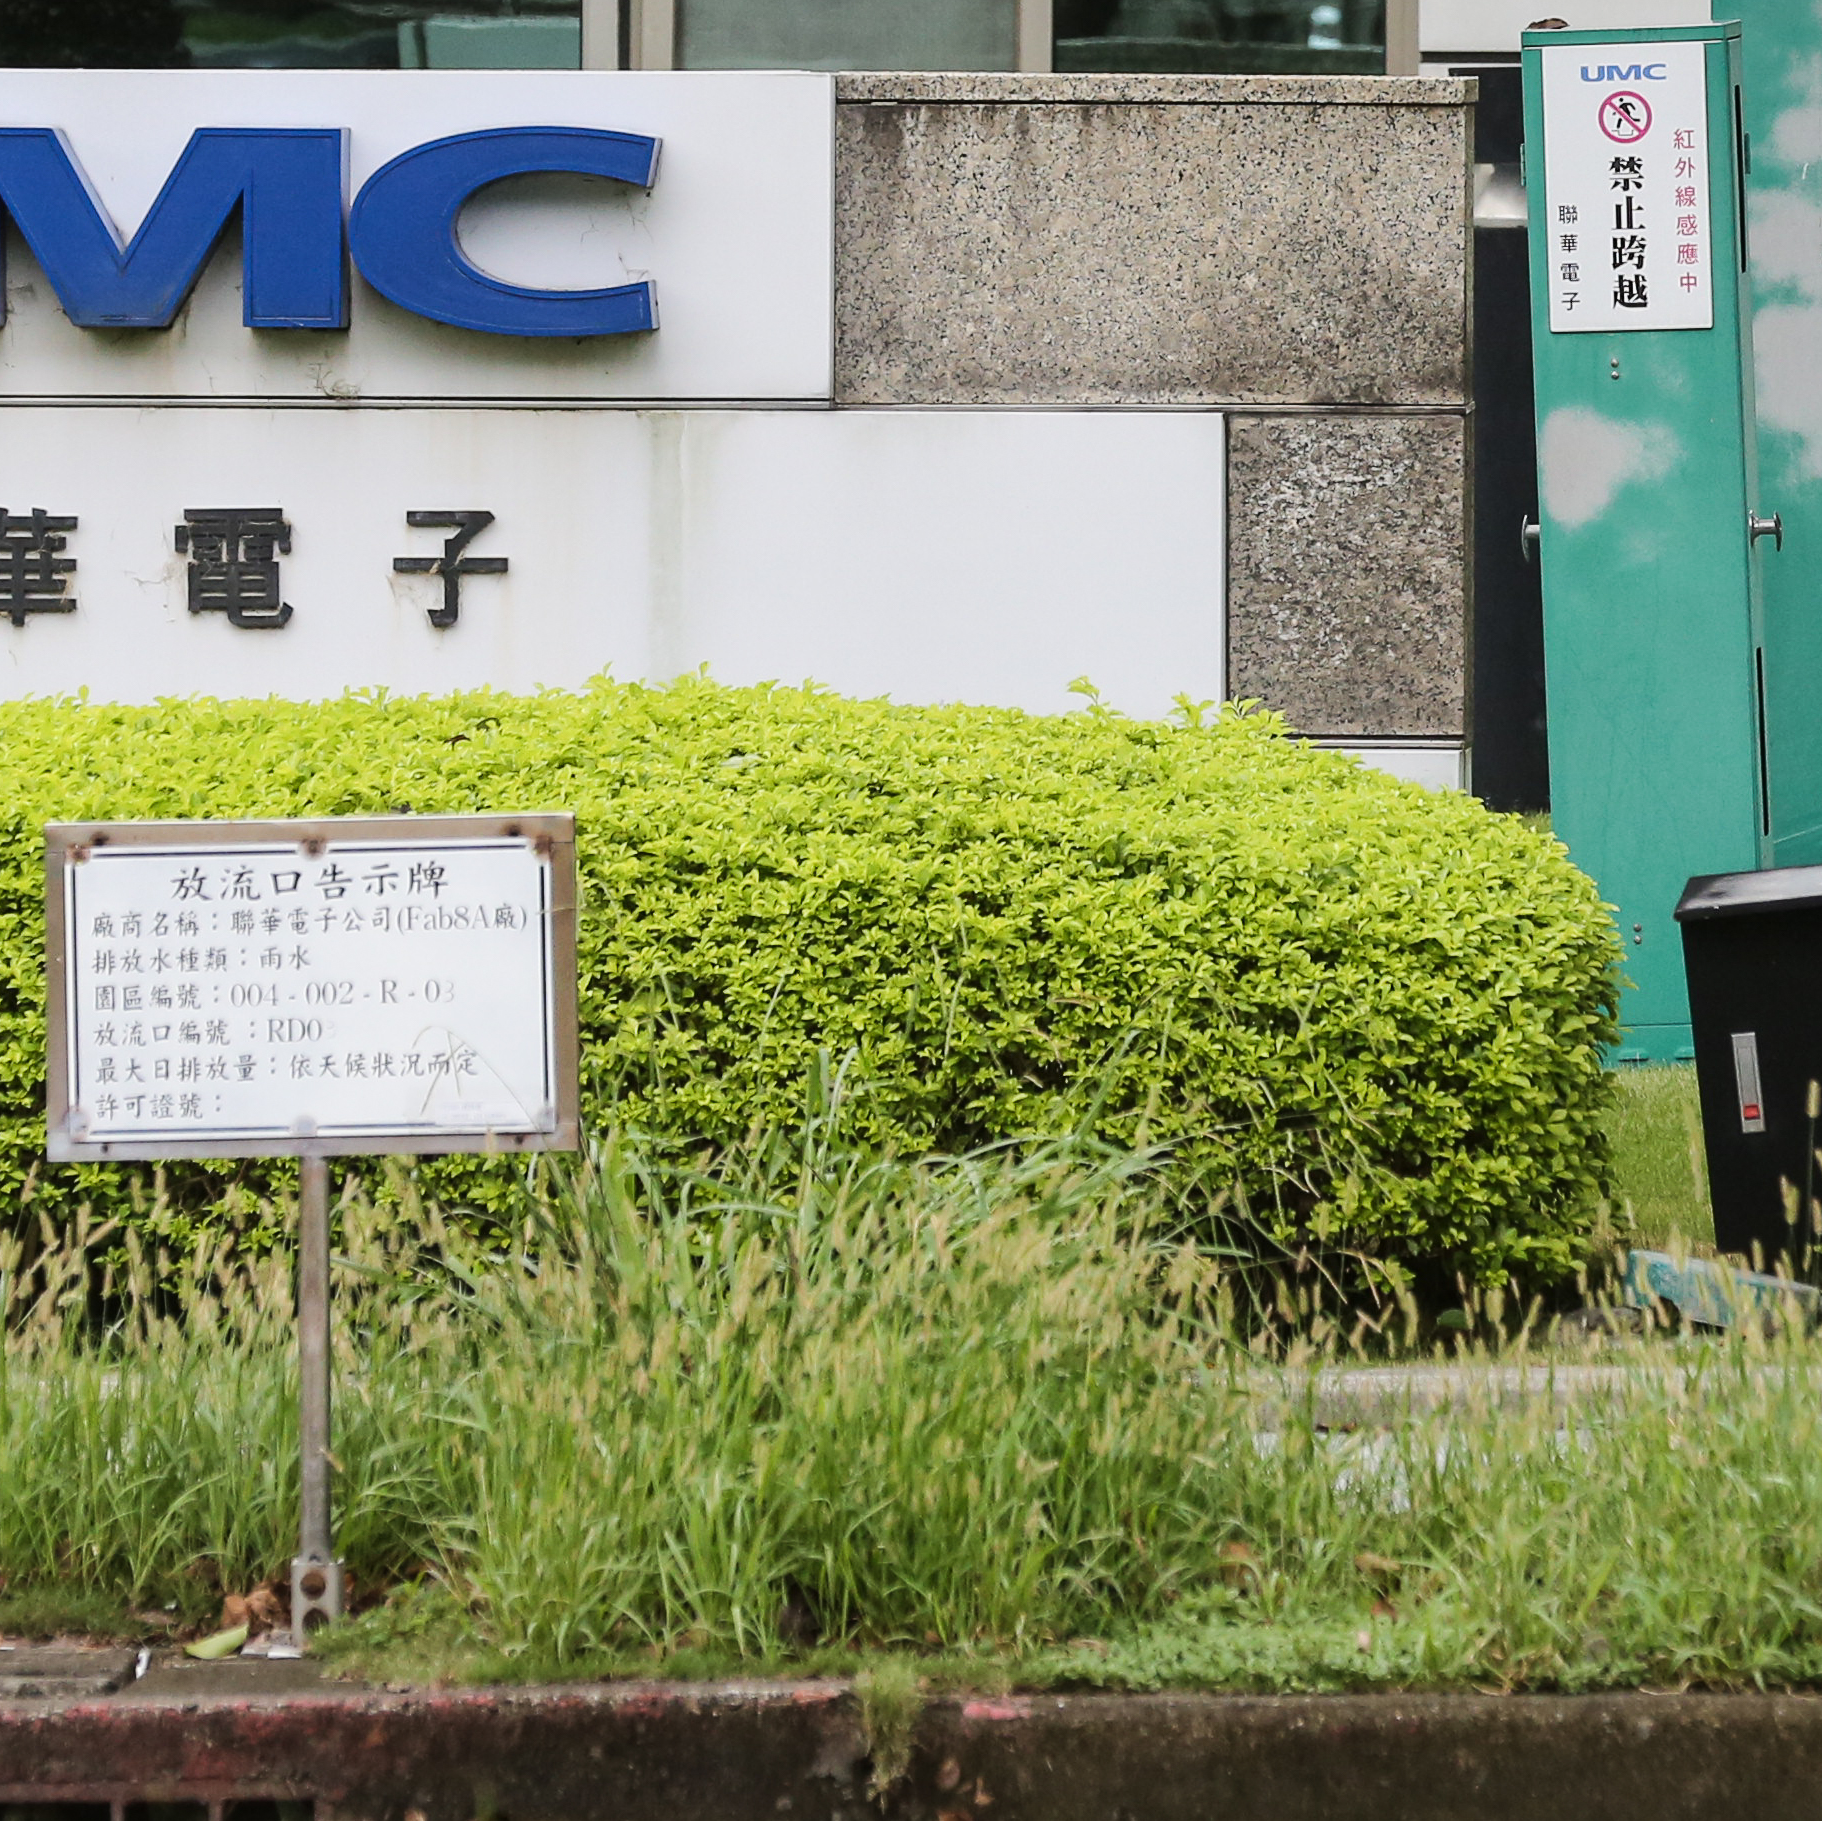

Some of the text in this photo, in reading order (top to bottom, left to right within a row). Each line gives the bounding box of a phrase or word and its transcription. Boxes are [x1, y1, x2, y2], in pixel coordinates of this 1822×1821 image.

[1580, 63, 1667, 82] UMC
[1608, 155, 1649, 310] 禁止跨越
[1673, 128, 1699, 294] 紅外線感應中
[1557, 204, 1581, 311] 聯華電子
[170, 860, 449, 902] 放流口告示牌
[91, 944, 311, 974] 排放水種類：雨水
